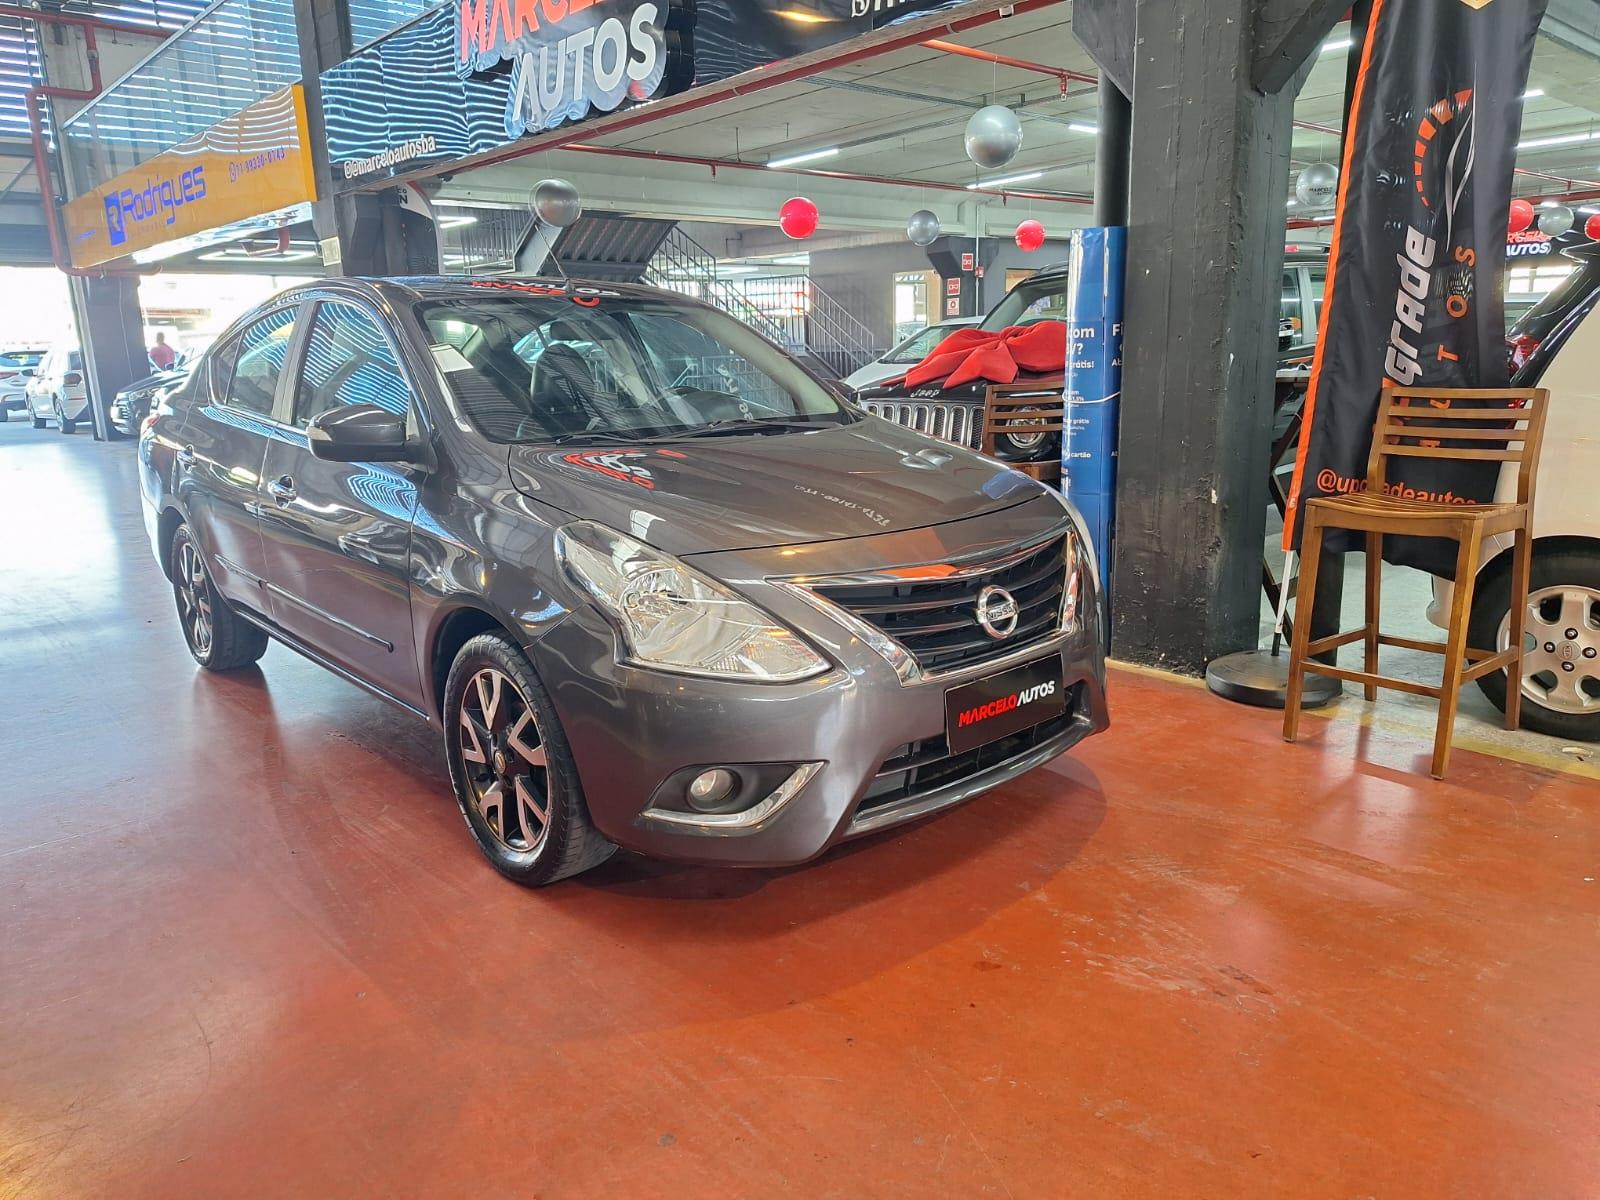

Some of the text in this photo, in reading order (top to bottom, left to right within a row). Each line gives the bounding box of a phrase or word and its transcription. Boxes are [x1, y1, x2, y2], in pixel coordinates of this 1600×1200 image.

[460, 0, 608, 64] MAR
[512, 2, 658, 121] AUTOS
[351, 133, 436, 177] @marceloautosba
[121, 165, 207, 225] Rodrigues
[910, 388, 940, 398] Jeep
